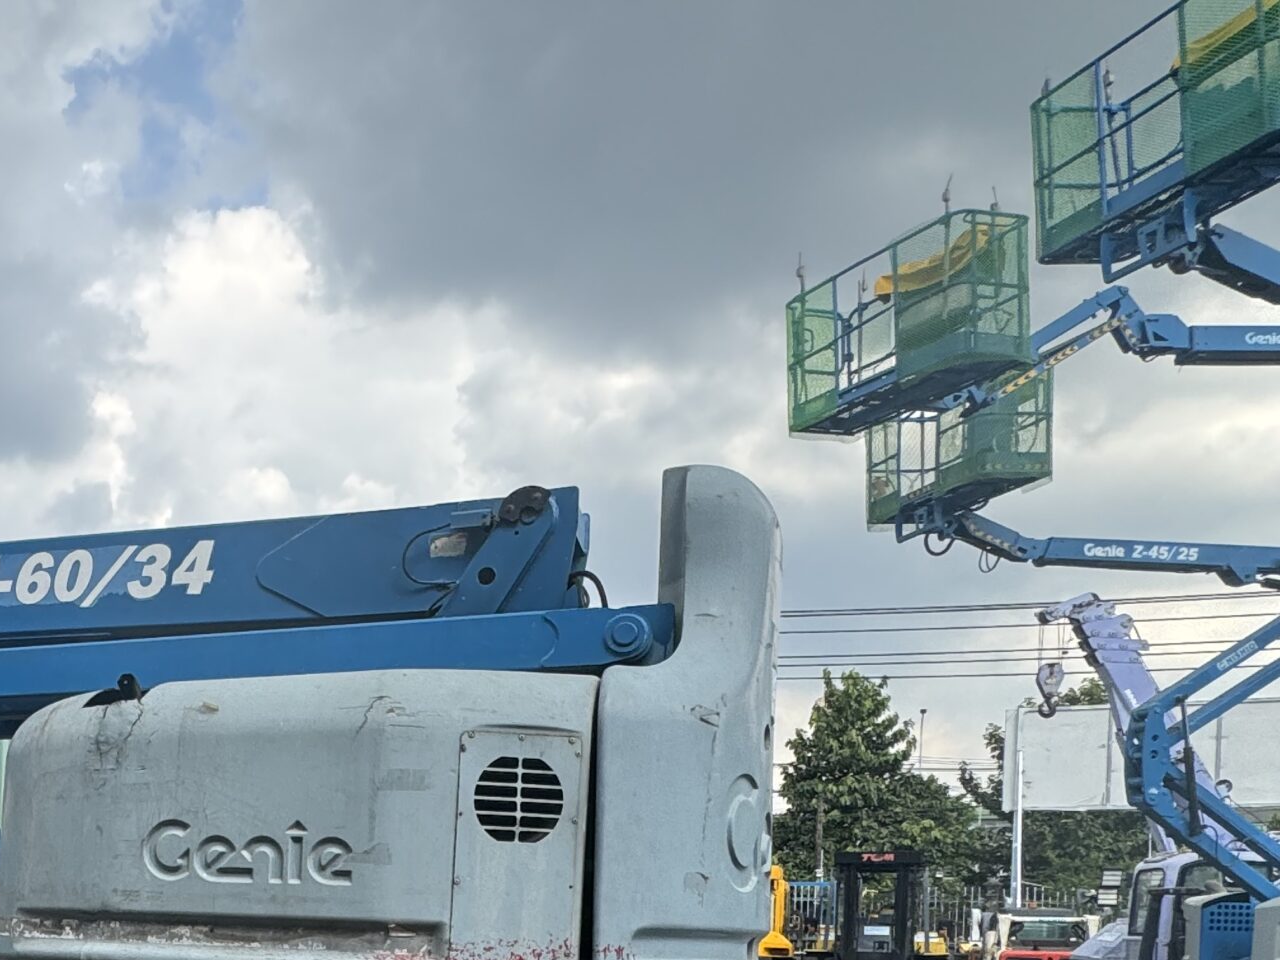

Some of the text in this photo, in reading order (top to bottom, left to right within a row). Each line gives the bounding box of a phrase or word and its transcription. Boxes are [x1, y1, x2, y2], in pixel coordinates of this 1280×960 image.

[1083, 543, 1199, 561] Genie Z-45/25
[143, 818, 353, 886] Genie
